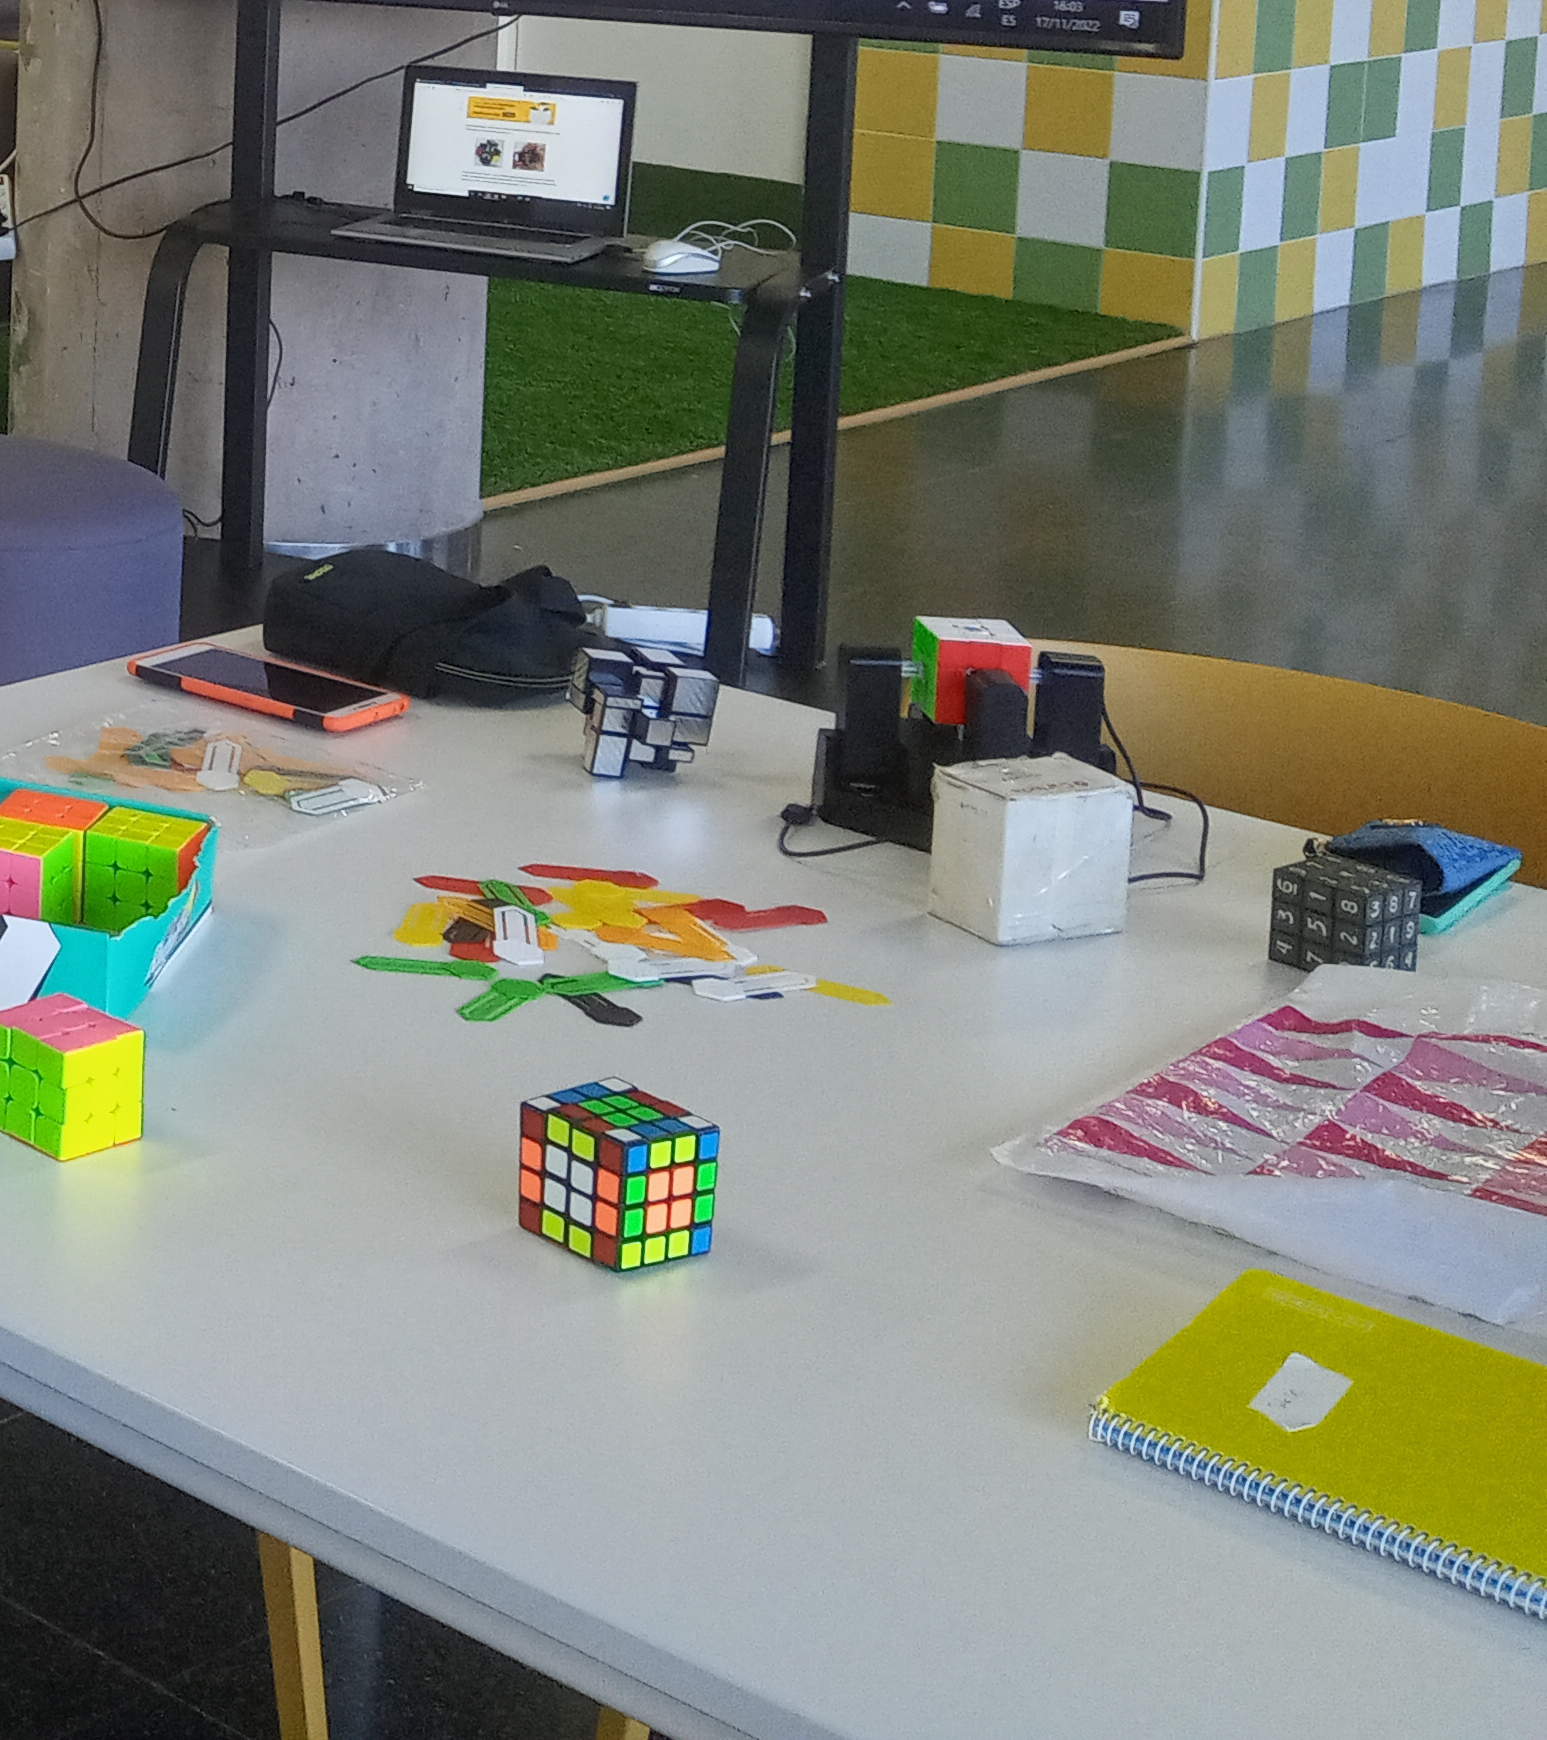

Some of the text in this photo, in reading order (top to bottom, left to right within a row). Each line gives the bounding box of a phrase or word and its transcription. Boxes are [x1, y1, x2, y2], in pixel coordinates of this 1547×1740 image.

[1001, 14, 1017, 27] ES
[1370, 891, 1417, 918] 3 8 7
[1340, 900, 1358, 945] 2 8
[1369, 921, 1415, 950] 2 1 9
